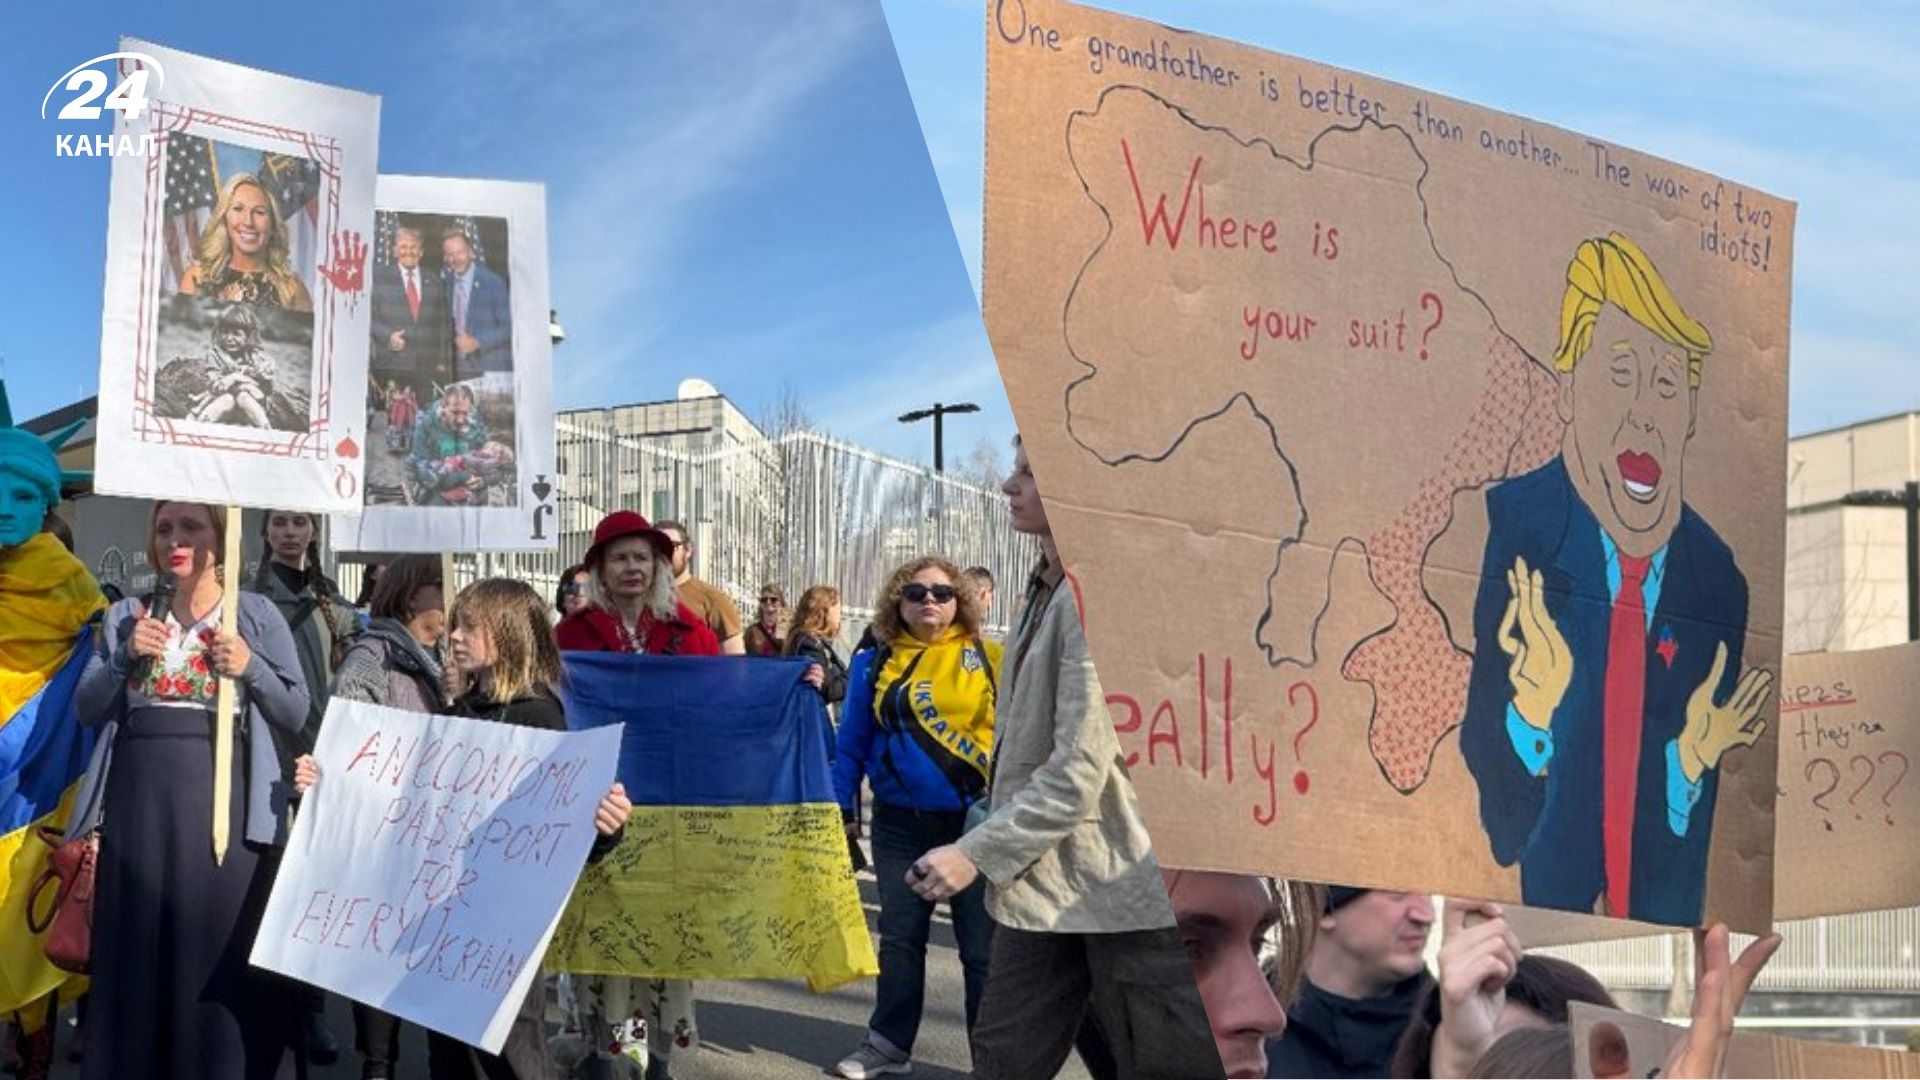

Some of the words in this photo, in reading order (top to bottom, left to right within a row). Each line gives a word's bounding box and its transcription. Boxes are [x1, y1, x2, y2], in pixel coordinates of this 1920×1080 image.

[996, 0, 1062, 51] One
[1088, 36, 1240, 86] grandfather
[1259, 71, 1279, 101] is
[1299, 75, 1385, 119] better
[1413, 101, 1463, 143] than
[1586, 141, 1631, 187] The
[1646, 172, 1690, 200] war
[1701, 181, 1725, 213] of
[1734, 193, 1772, 230] two
[1121, 139, 1277, 253] Where
[1313, 221, 1340, 260] is
[1700, 224, 1771, 272] idiots!
[1240, 305, 1318, 361] your
[1349, 292, 1444, 361] suit?
[530, 504, 553, 540] J
[345, 731, 417, 787] AN
[402, 859, 479, 909] FOR
[291, 887, 417, 959] EVERY
